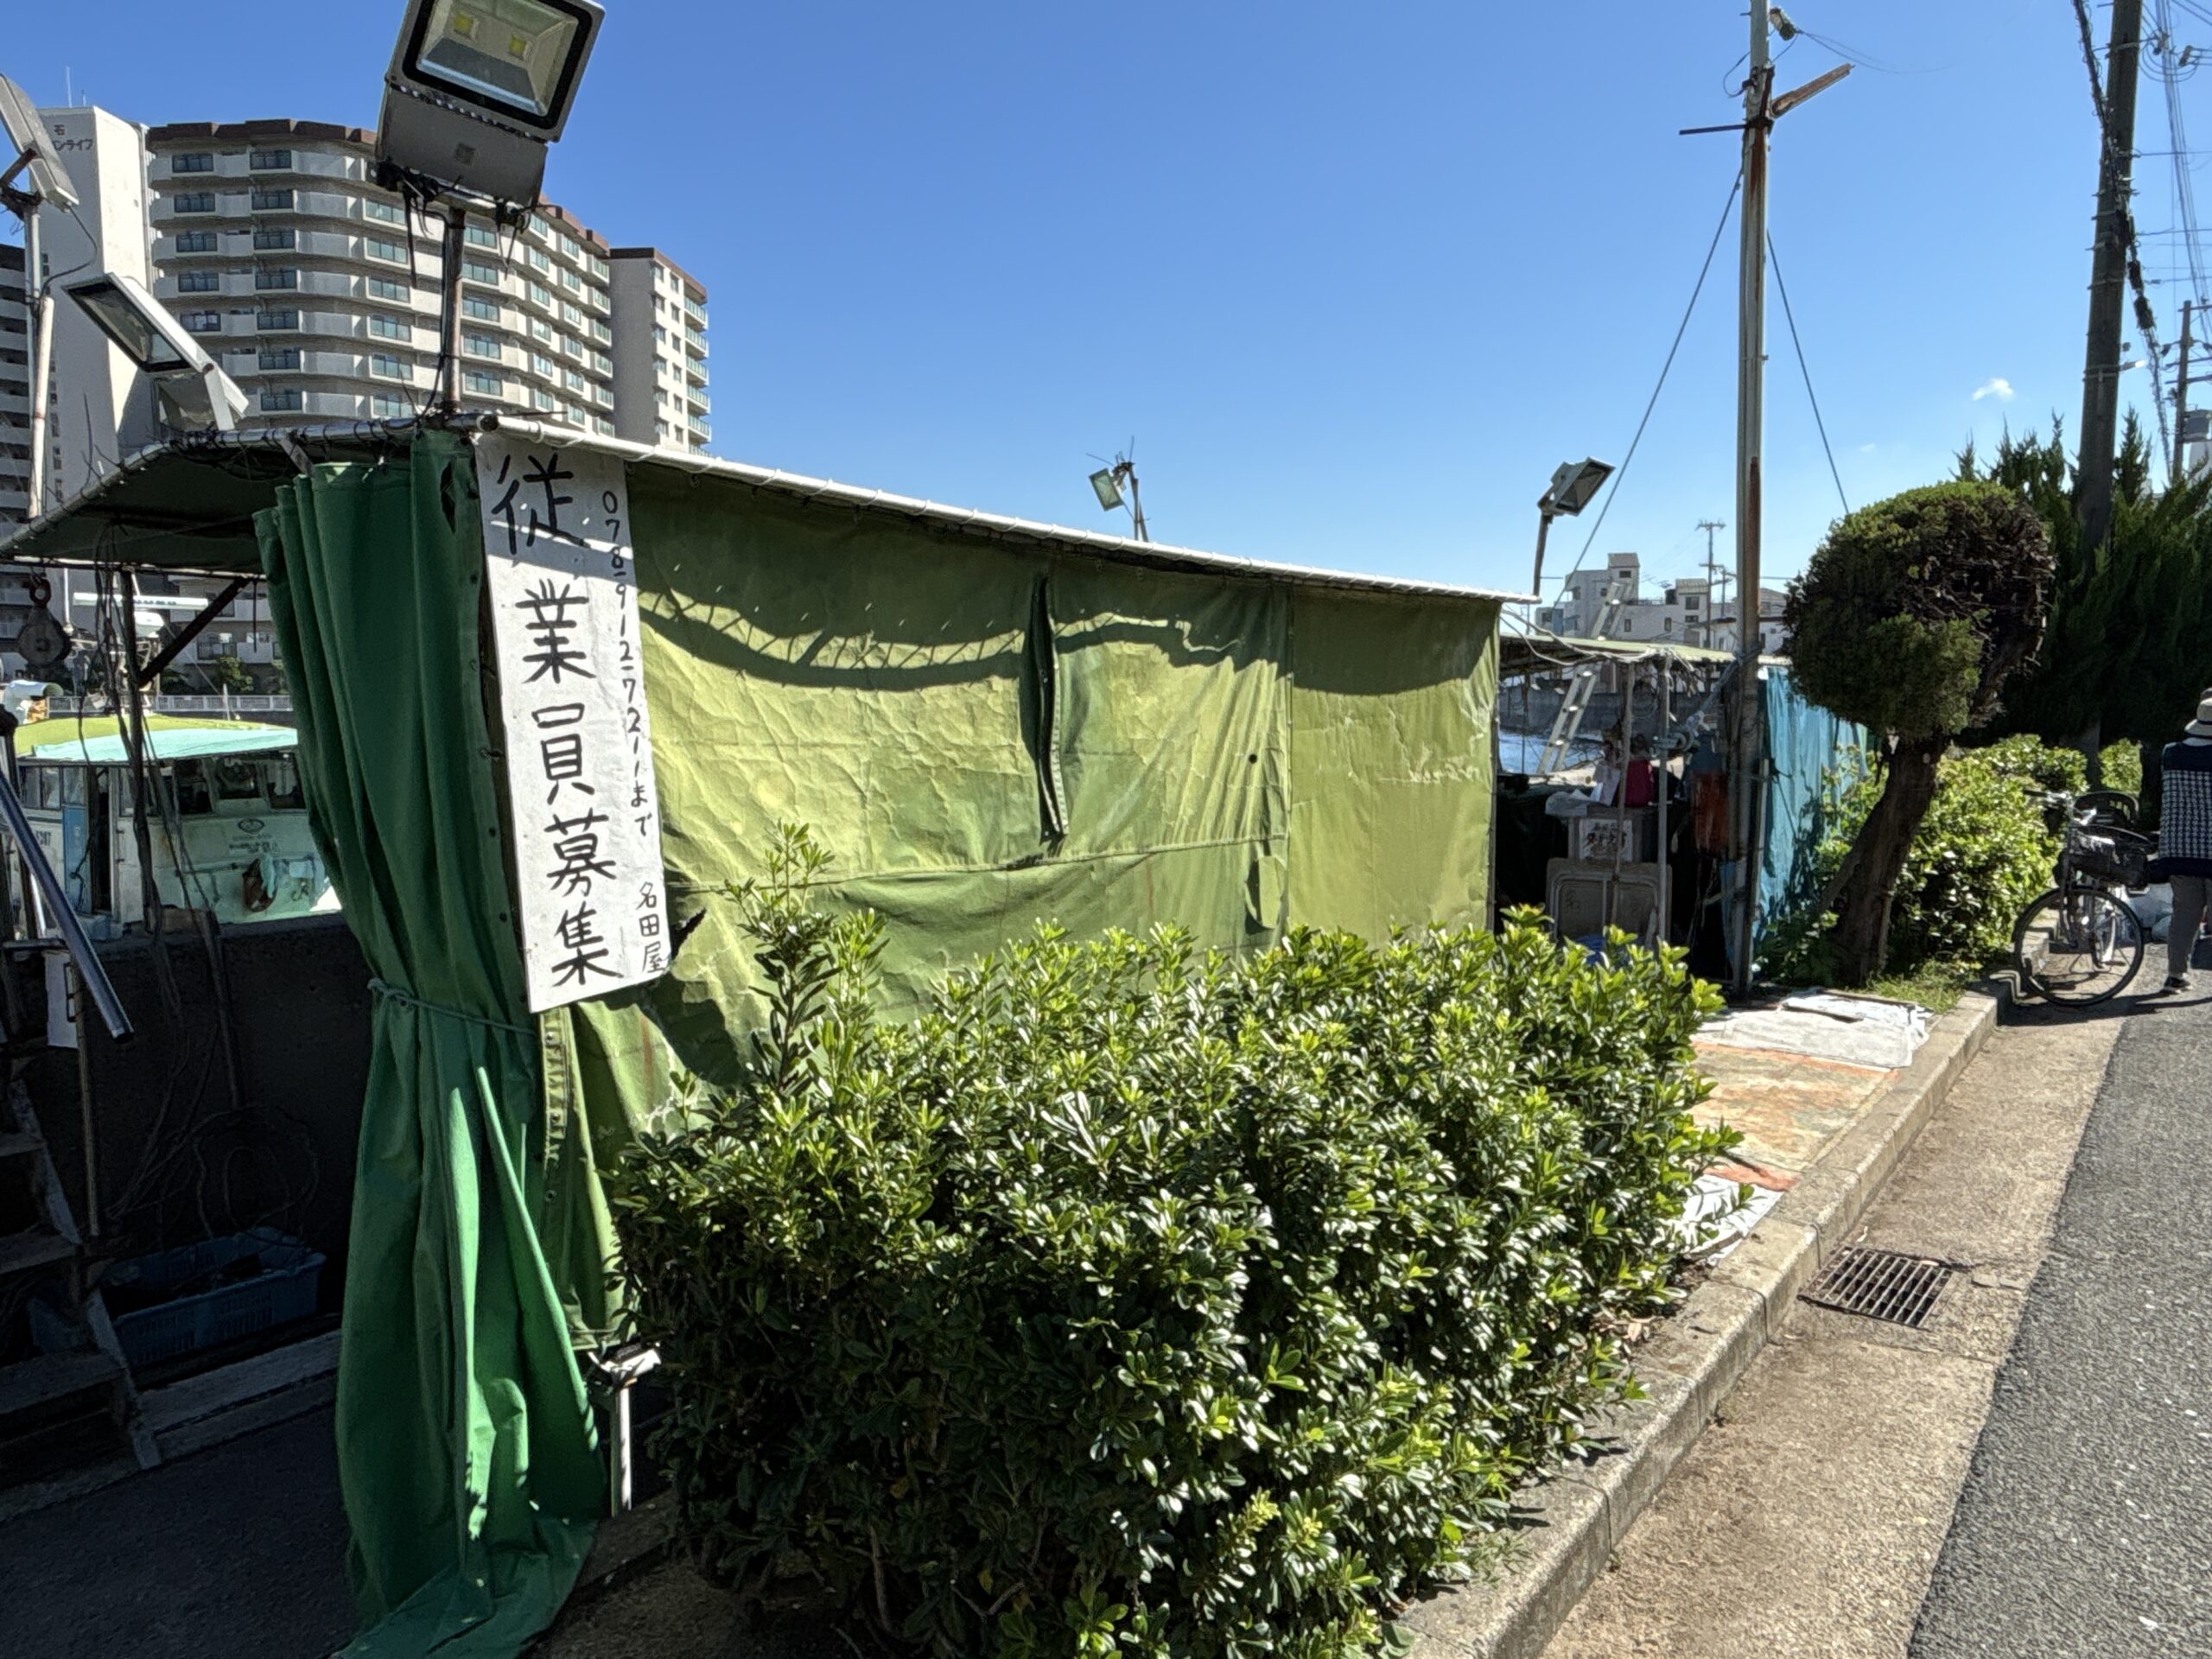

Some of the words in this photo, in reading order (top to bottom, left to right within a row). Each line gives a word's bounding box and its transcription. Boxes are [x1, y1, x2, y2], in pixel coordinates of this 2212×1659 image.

[492, 453, 625, 987] 従業員募集
[635, 880, 665, 974] 名田屋
